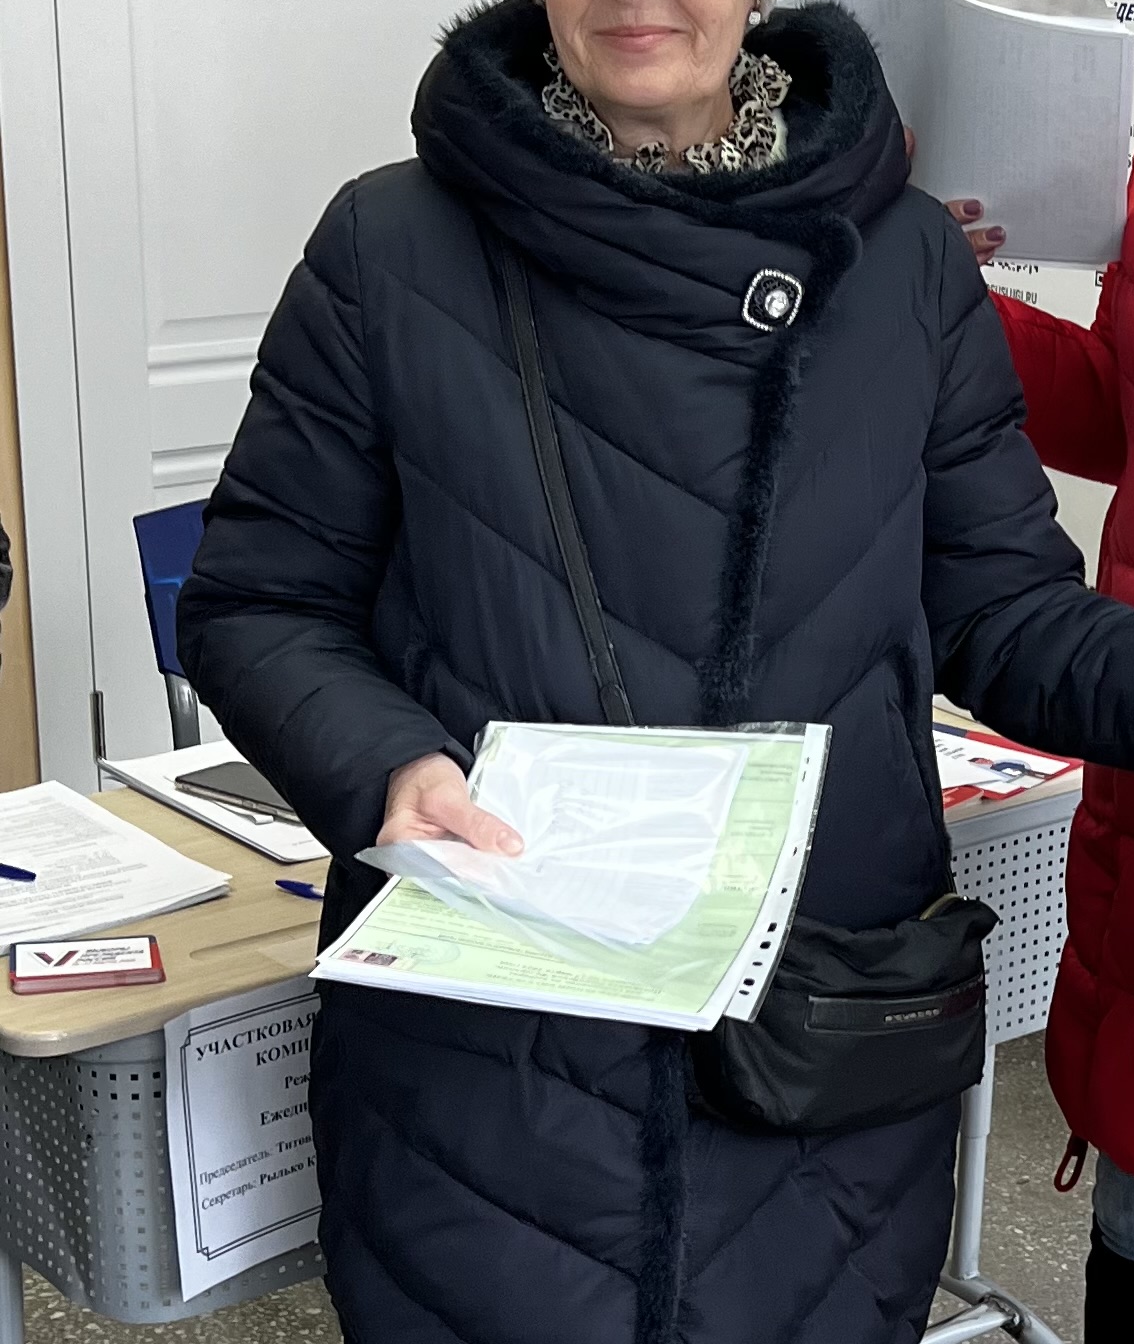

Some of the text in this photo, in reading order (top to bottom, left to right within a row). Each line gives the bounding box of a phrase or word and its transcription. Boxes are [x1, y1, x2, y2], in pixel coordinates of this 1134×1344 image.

[196, 1012, 317, 1062] УЧАСТКОВАЯ
[255, 1037, 311, 1067] КОМИ
[284, 1071, 311, 1089] Реж
[260, 1101, 308, 1126] Ежедн
[276, 1135, 313, 1154] Титов
[201, 1179, 258, 1211] Секретарь:
